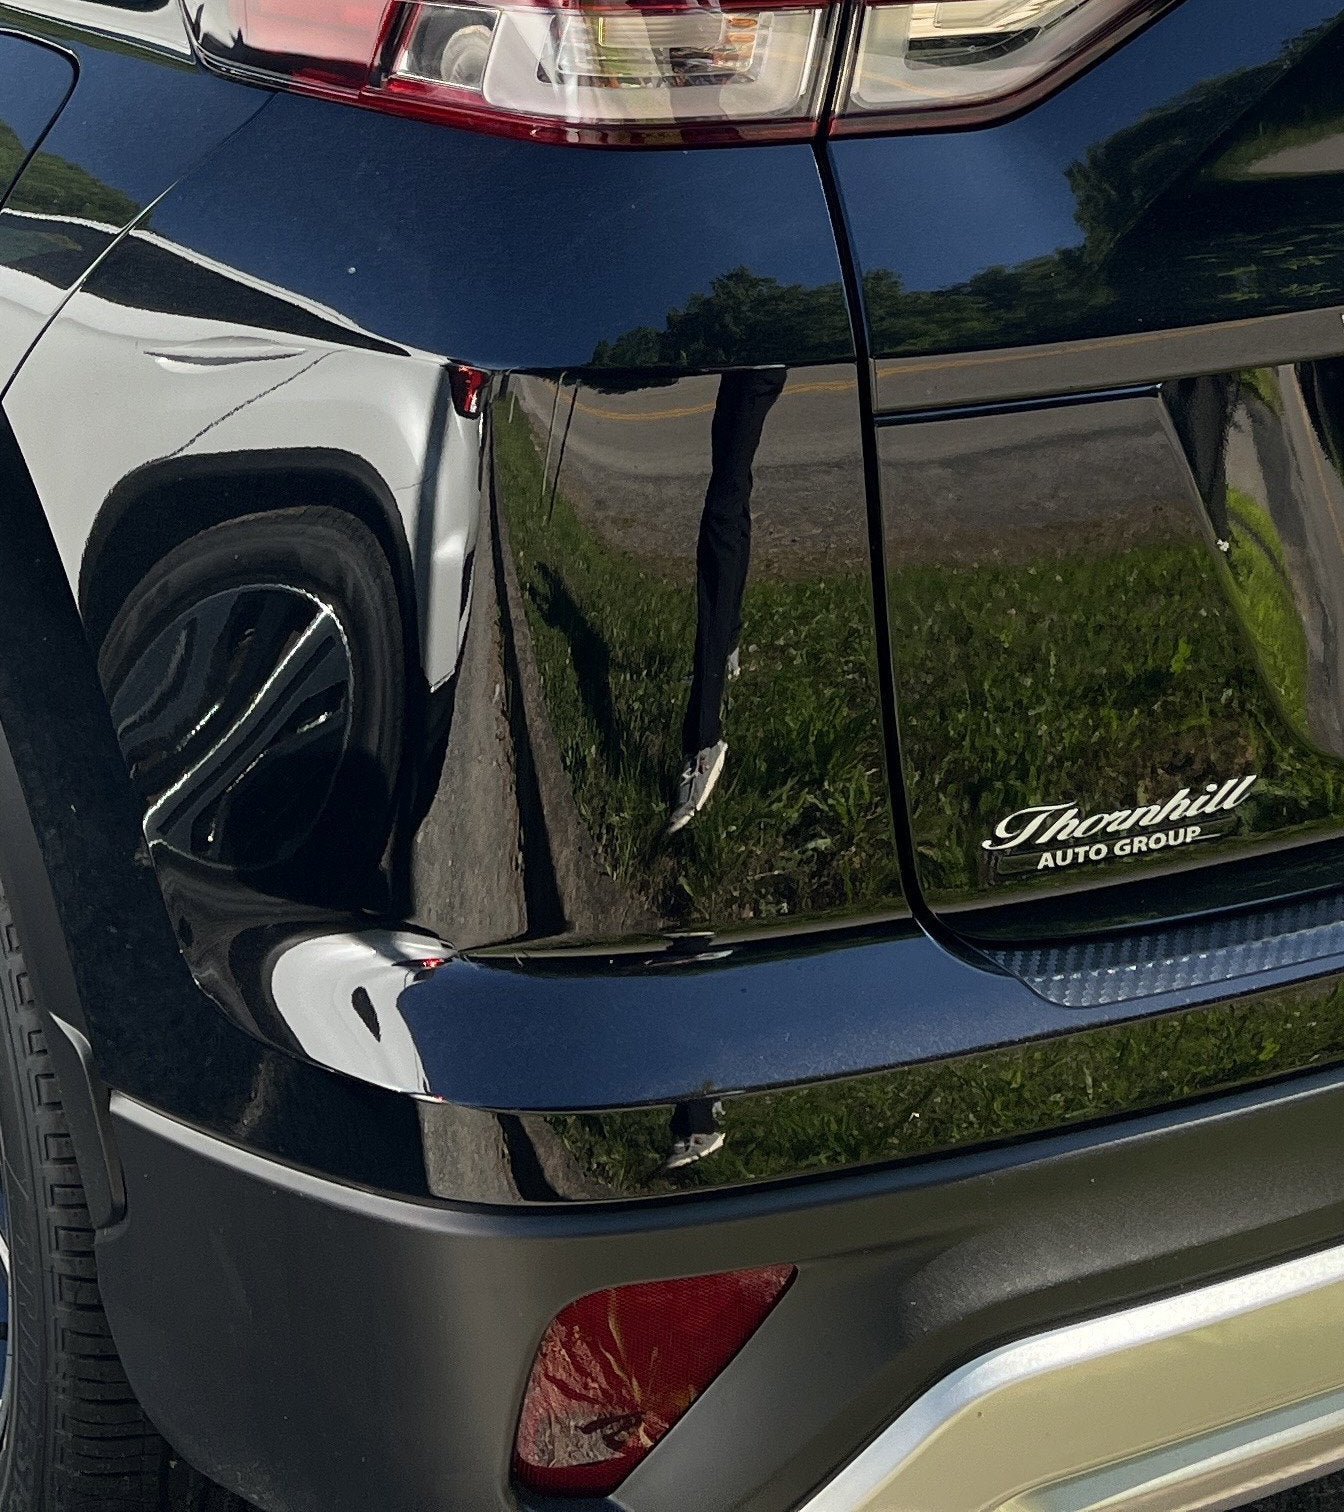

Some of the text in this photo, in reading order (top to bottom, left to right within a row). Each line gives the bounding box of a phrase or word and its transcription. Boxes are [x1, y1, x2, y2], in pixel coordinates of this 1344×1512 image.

[982, 774, 1257, 851] Thornhill
[1037, 825, 1202, 870] AUTO GROUP
